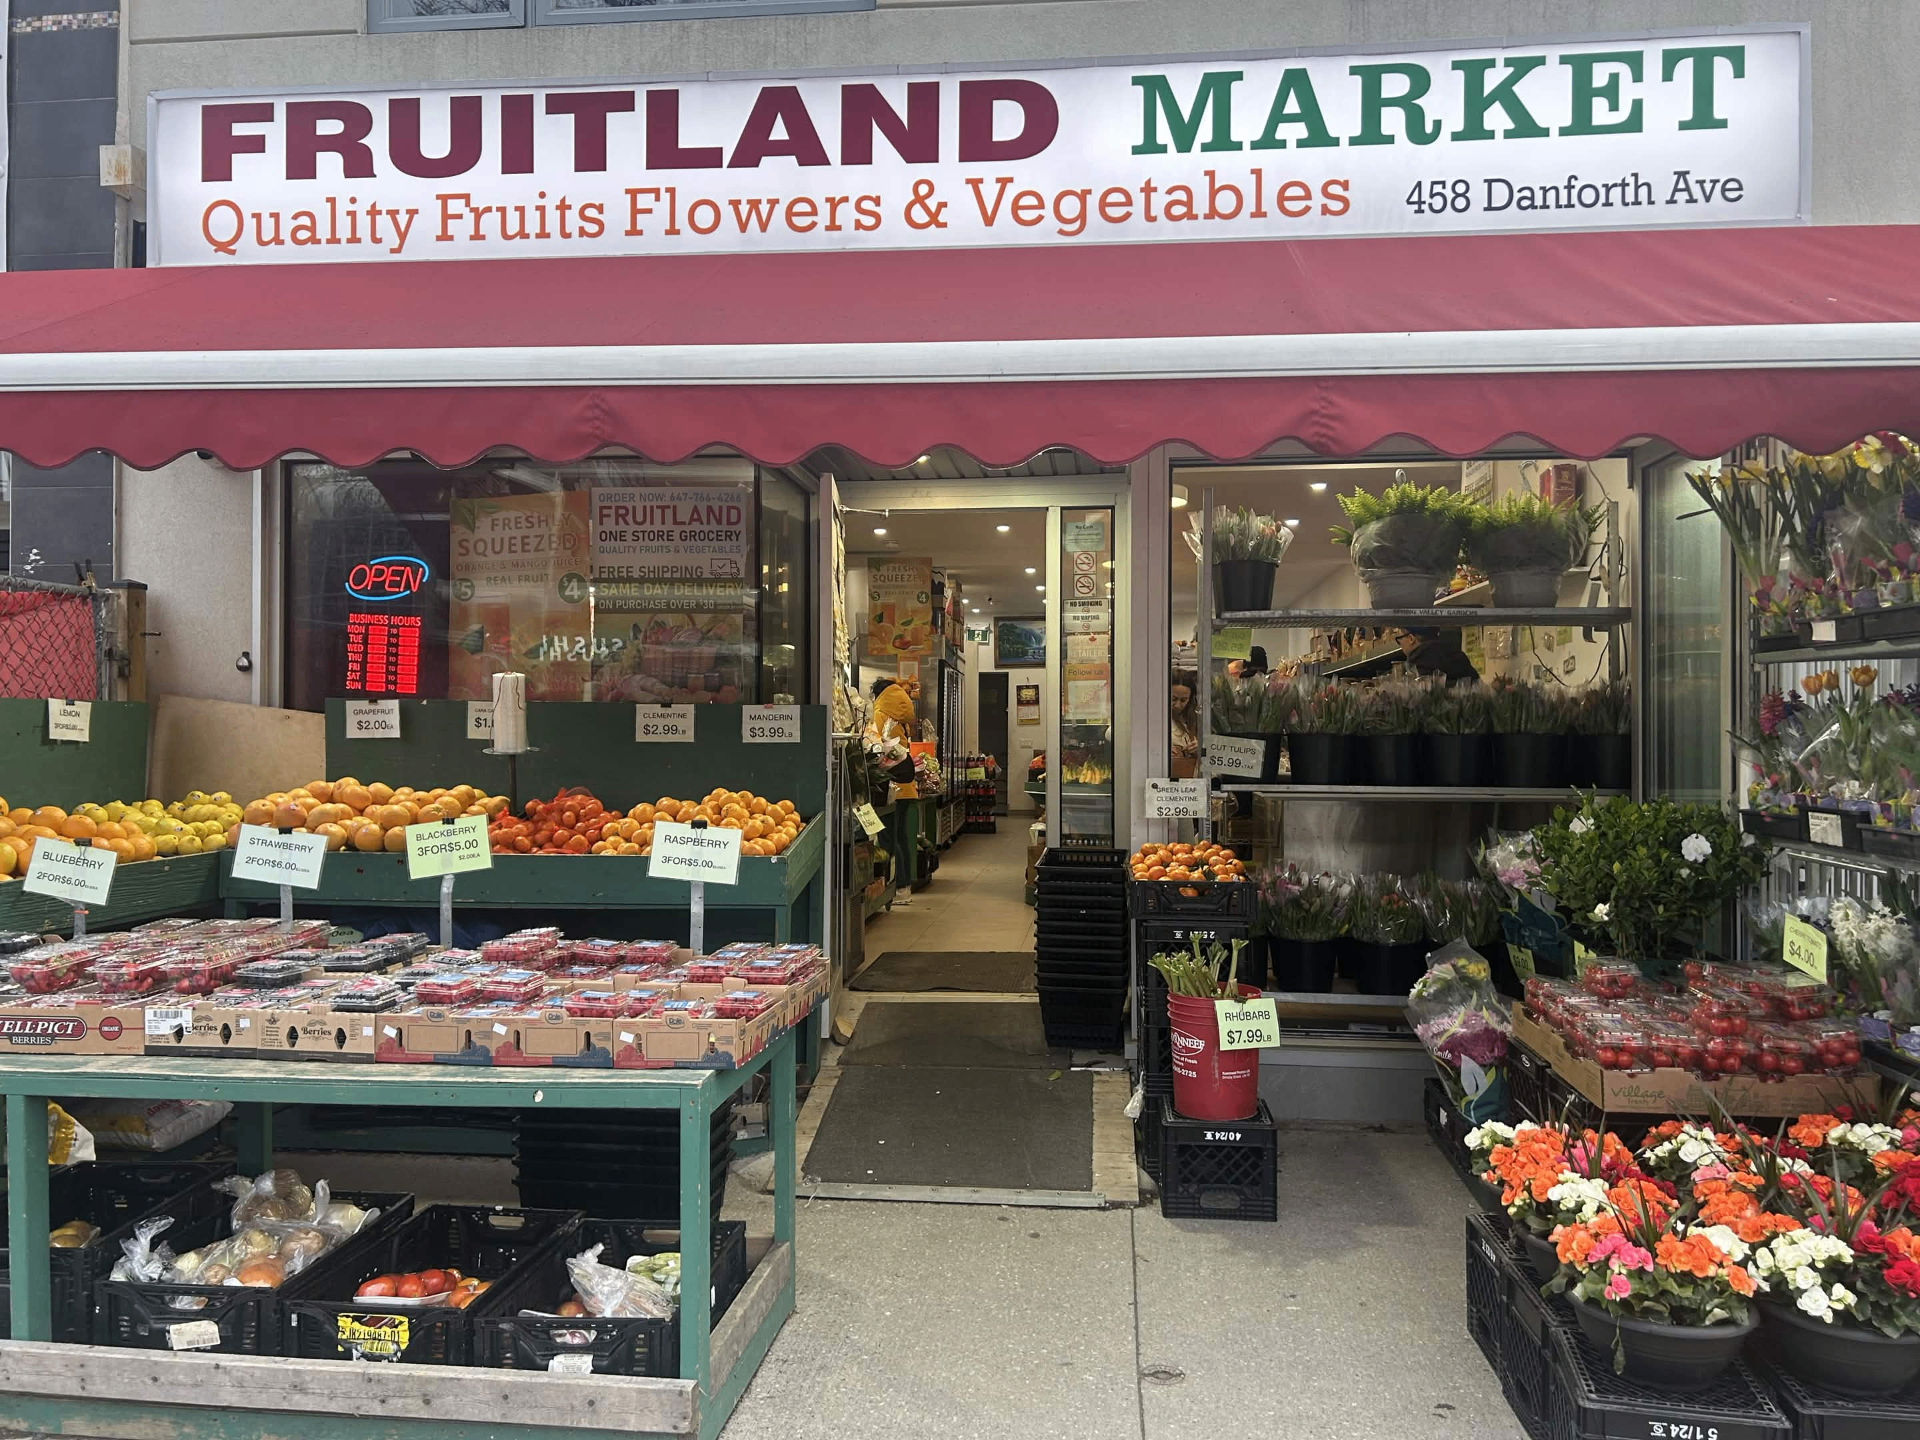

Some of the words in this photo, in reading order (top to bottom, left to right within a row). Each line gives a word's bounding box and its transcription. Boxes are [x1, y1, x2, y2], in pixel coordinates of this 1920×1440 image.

[201, 79, 1059, 182] FRUITLAND
[1131, 45, 1746, 156] MARKET
[1405, 179, 1471, 215] 458
[1482, 170, 1655, 214] Danforth
[1665, 169, 1745, 205] Ave
[201, 196, 419, 256] Quality
[435, 190, 605, 242] Fruits
[625, 185, 882, 237] Flowers
[904, 178, 948, 230] &
[965, 169, 1352, 237] Vegetables
[598, 493, 635, 502] ORDER
[639, 492, 666, 502] NOW:
[490, 512, 572, 532] FRESHLY
[598, 505, 742, 526] FRUITLAND
[599, 530, 627, 542] ONE
[631, 530, 674, 542] STORE
[679, 530, 742, 542] GROCERY
[457, 532, 577, 557] SQUEEZED
[598, 546, 637, 554] QUALITY
[639, 546, 671, 554] FRUITS
[673, 546, 680, 554] &
[683, 545, 741, 554] VEGETABLES
[456, 561, 497, 572] ORANGE
[511, 558, 548, 569] MANGO
[551, 557, 580, 566] JUICE
[348, 563, 424, 593] OPEN
[598, 565, 634, 578] FREE
[638, 565, 704, 578] SHIPPING
[486, 575, 512, 586] REAL
[518, 573, 550, 584] FRUIT
[562, 577, 582, 600] $4
[600, 583, 639, 596] SAME
[644, 583, 669, 596] DAY
[674, 582, 742, 596] DELIVERY
[598, 600, 613, 609] ON
[616, 600, 667, 609] PURCHASE
[669, 600, 697, 609] OVER
[700, 600, 714, 609] $30
[349, 613, 389, 624] BUSINESS
[390, 615, 421, 626] HOURS
[347, 624, 365, 634] MON
[348, 634, 363, 643] TUE
[347, 643, 364, 652] WED
[347, 652, 362, 661] THU
[348, 662, 360, 671] FRI
[1067, 668, 1093, 677] Follow
[346, 671, 360, 680] SAT
[346, 681, 361, 689] SUN
[59, 709, 80, 718] LEMON
[352, 708, 394, 716] GRAPEFRUIT
[1210, 743, 1227, 752] CUT
[1229, 745, 1257, 755] TULIPS
[415, 825, 477, 842] BLACKBERRY
[248, 837, 314, 854] STRAWBERRY
[417, 838, 479, 857] 3FOR$5.00
[664, 834, 729, 850] RASPBERRY
[42, 850, 104, 870] BLUEBERRY
[245, 855, 297, 871] 2FOR$6.00
[661, 855, 714, 869] 3FOR$5.00
[36, 871, 86, 888] 2FOR$6.00
[1788, 939, 1815, 968] $4.00
[1224, 1010, 1271, 1022] RHUBARB
[301, 1026, 332, 1036] Berries
[12, 1036, 52, 1045] BERRIES
[1611, 1086, 1666, 1104] Village
[1215, 1131, 1242, 1141] 40/24
